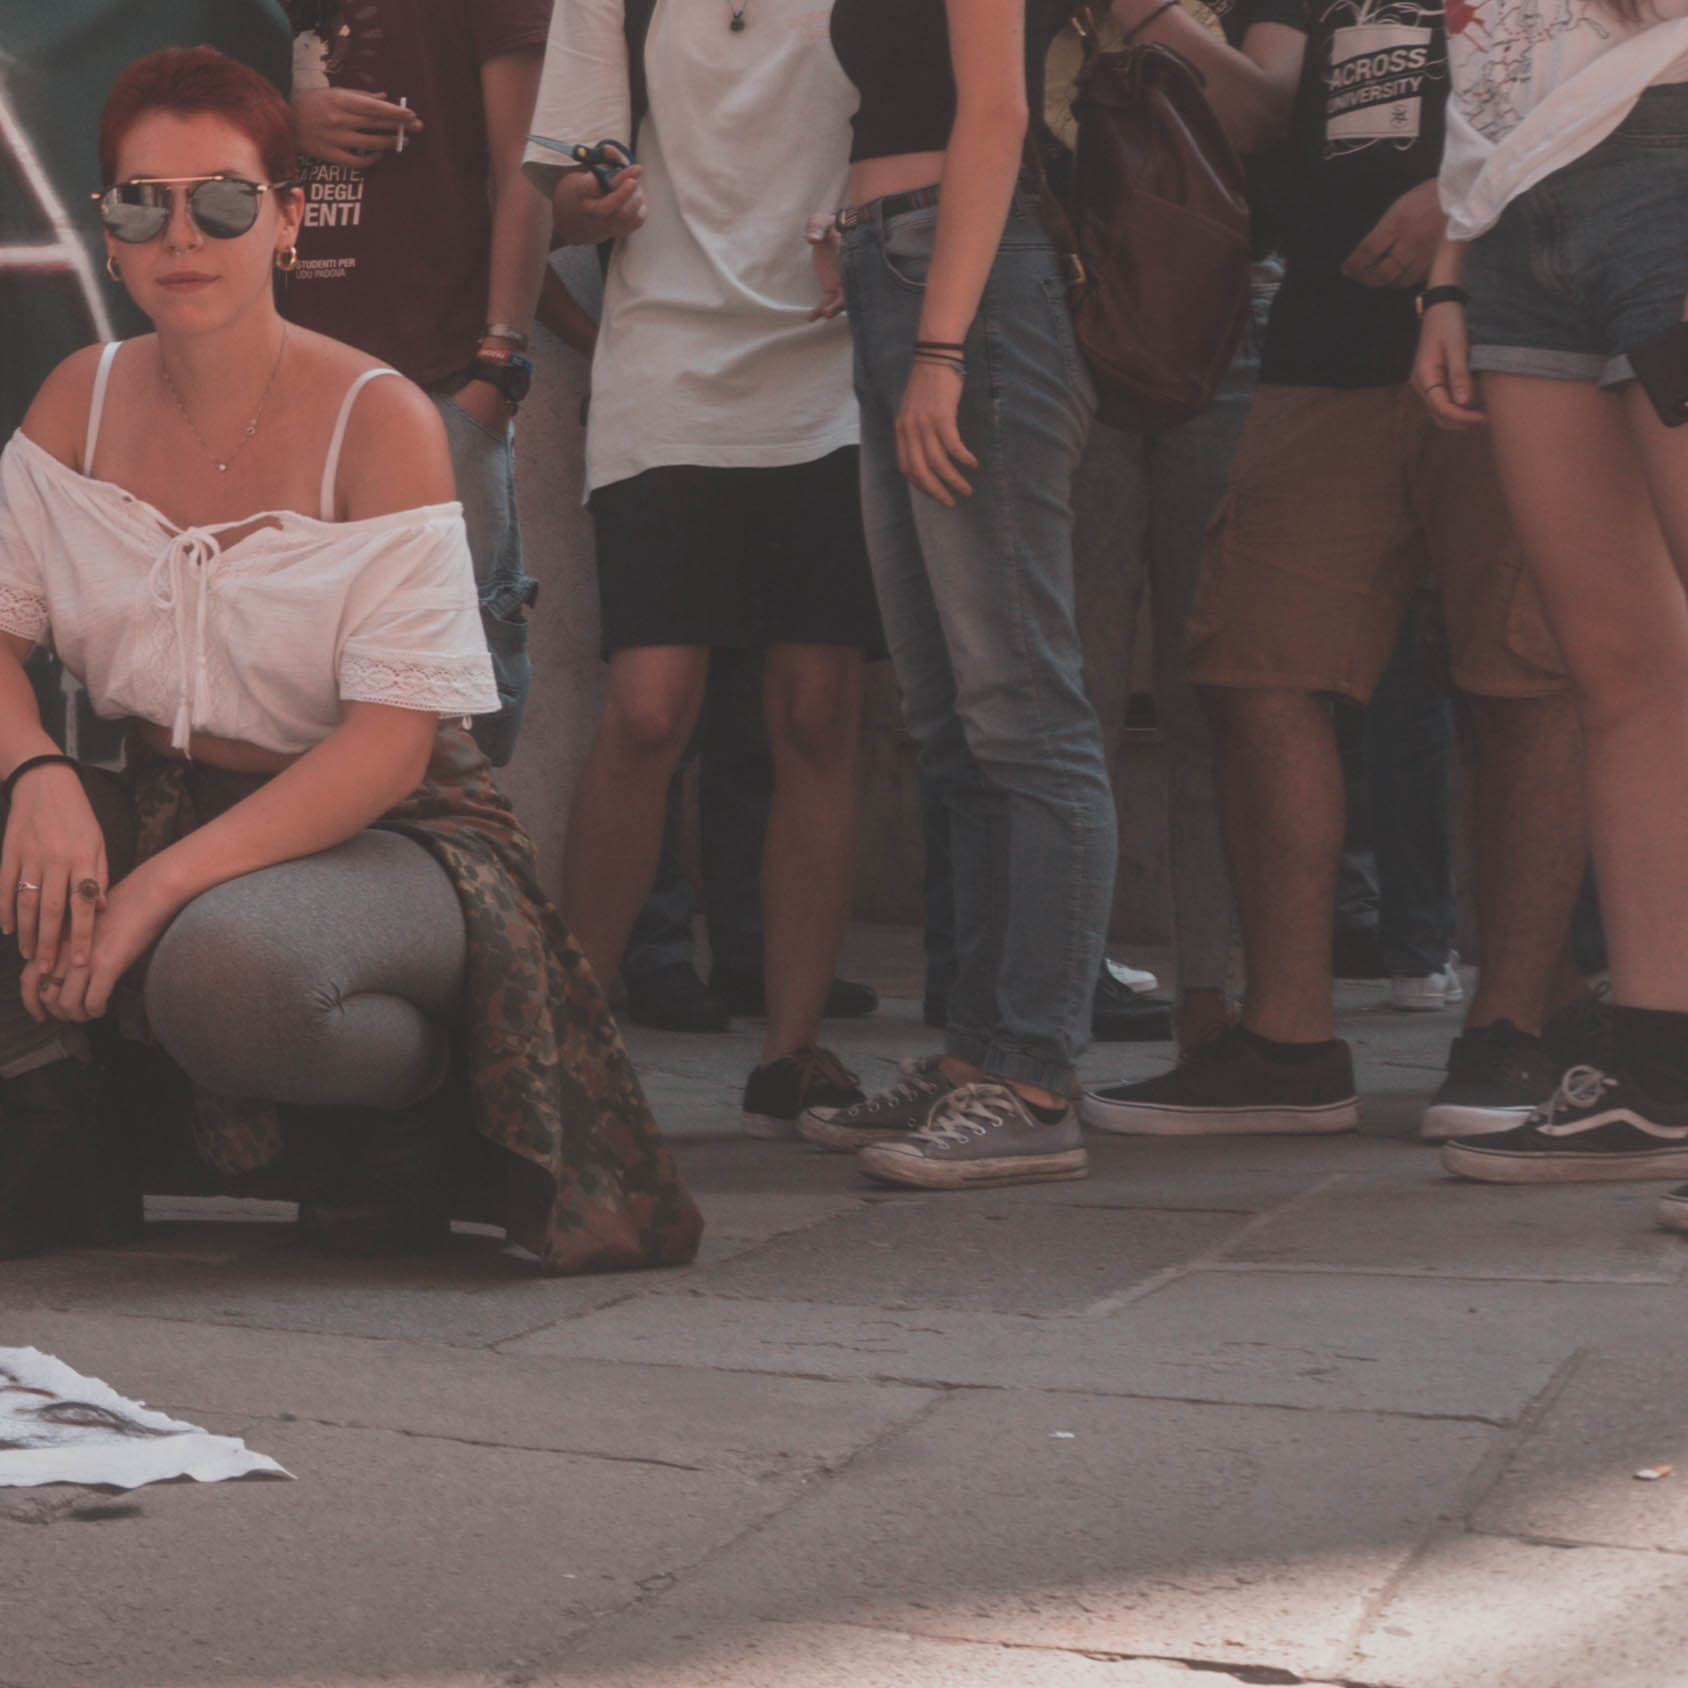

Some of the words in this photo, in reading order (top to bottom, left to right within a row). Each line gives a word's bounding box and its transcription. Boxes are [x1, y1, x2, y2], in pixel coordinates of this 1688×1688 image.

[1327, 48, 1428, 90] ACROSS
[310, 183, 364, 201] DEGLI
[304, 202, 361, 227] ENTI
